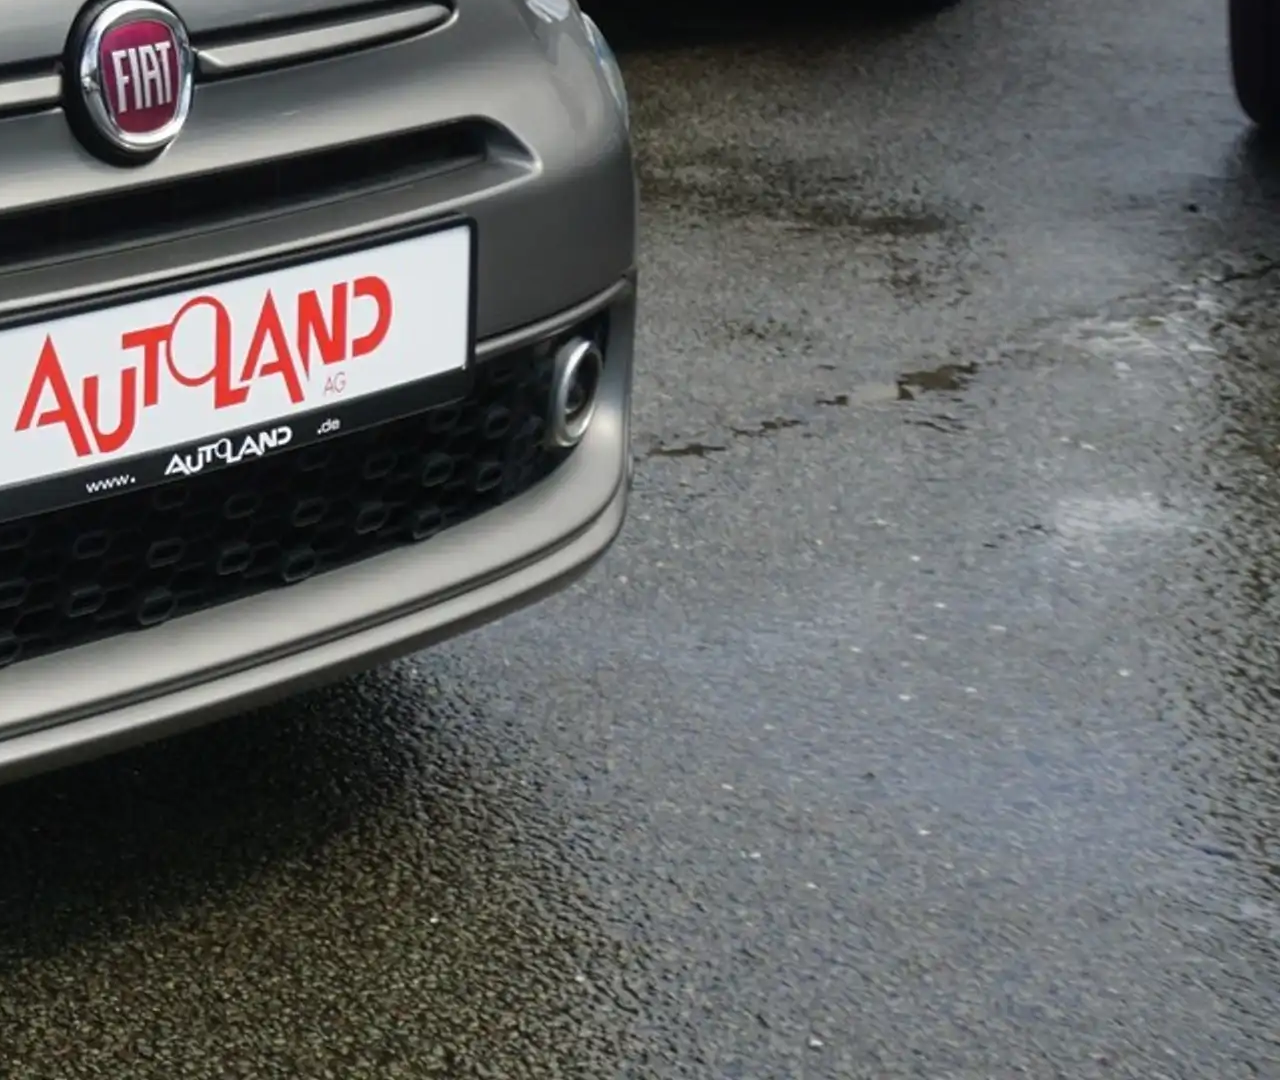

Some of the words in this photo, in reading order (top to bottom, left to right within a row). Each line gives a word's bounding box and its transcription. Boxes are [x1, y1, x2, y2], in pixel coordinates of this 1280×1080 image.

[111, 40, 171, 113] FIAT
[15, 275, 393, 457] AUTOLAND
[323, 371, 346, 396] AG
[86, 474, 136, 493] www.
[163, 425, 293, 476] AUTOLAND
[316, 418, 341, 435] .de
